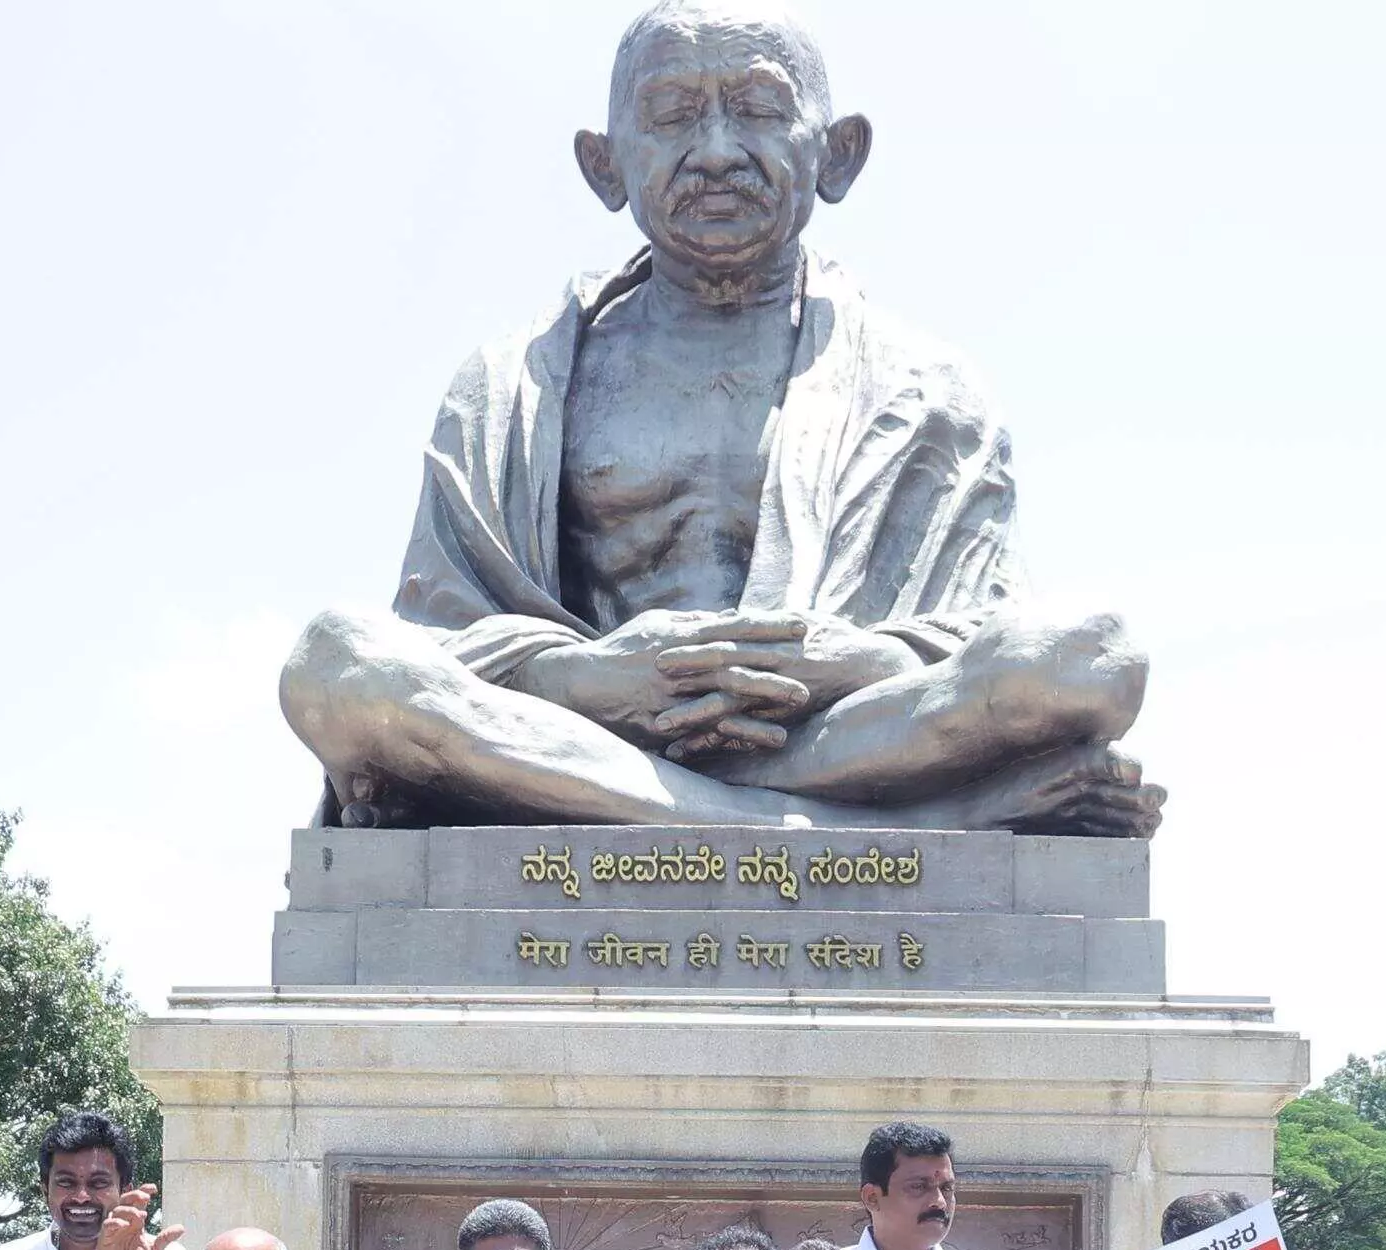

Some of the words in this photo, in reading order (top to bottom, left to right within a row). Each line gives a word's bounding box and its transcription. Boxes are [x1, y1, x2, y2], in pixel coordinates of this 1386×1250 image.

[522, 845, 580, 898] ನನ್ನ
[591, 845, 725, 883] ಜೀವನವೇ
[738, 846, 798, 900] ನನ್ನ
[810, 847, 919, 884] ಸಂದೇಶ
[519, 933, 569, 967] मेरा
[588, 933, 669, 968] जीवन
[688, 934, 720, 967] ही
[737, 934, 788, 968] मेरा
[808, 934, 882, 968] संदेश
[899, 933, 924, 969] है
